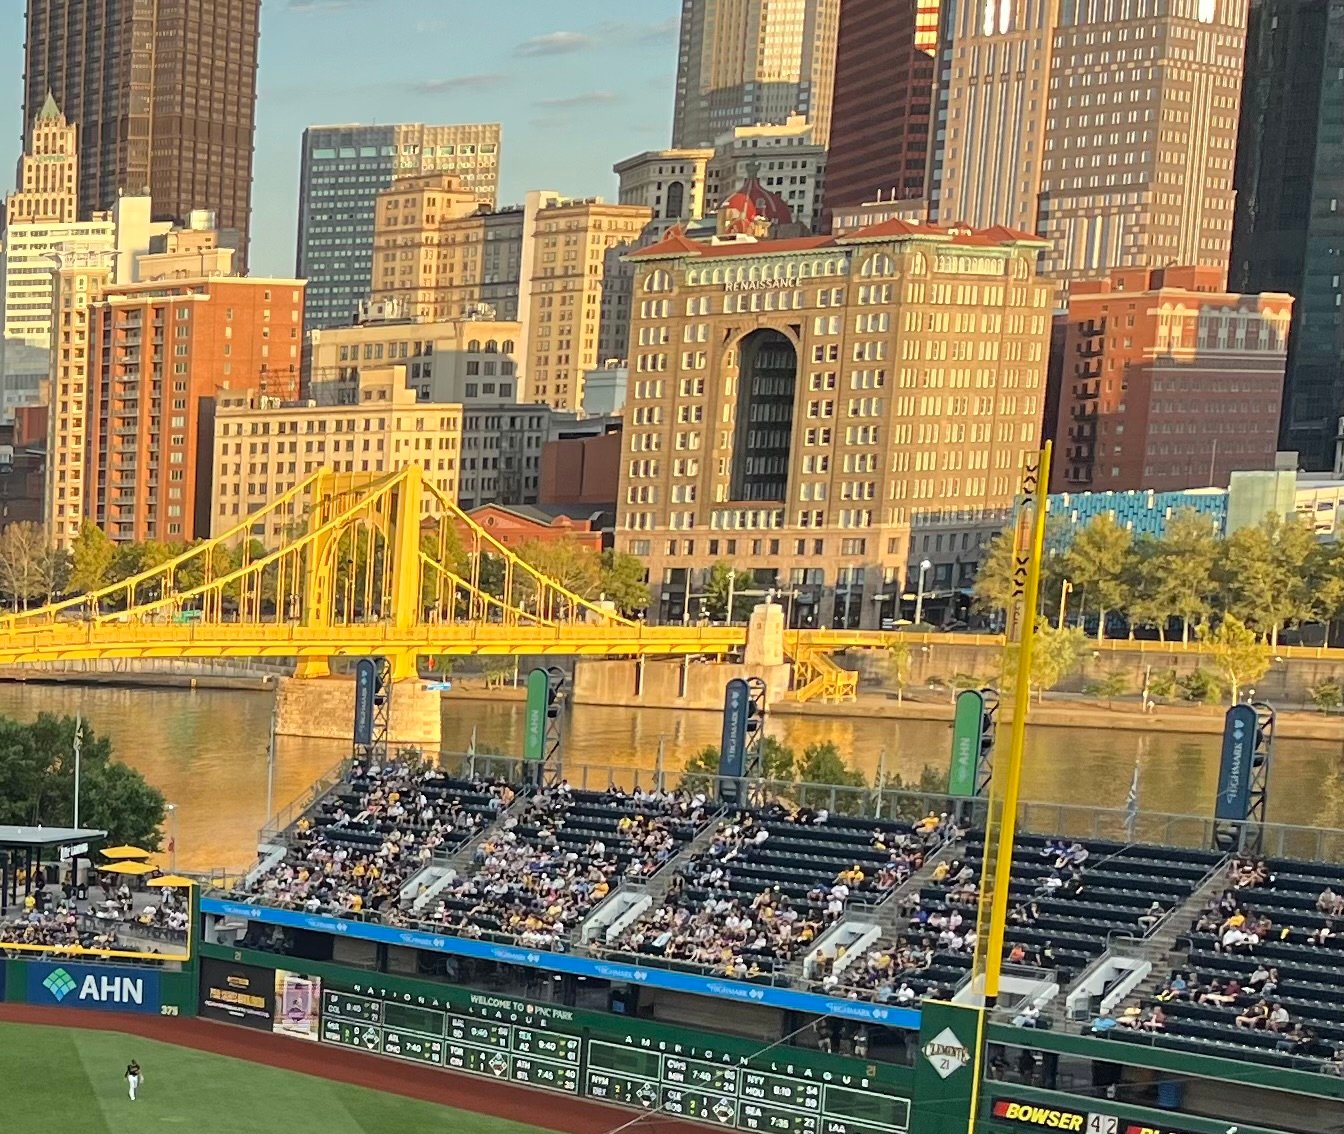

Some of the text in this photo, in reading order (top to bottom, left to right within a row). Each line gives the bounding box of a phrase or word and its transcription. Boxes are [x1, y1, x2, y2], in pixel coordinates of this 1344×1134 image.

[725, 278, 801, 292] RENAISSANCE
[1226, 742, 1243, 804] HIGHMARK
[79, 974, 143, 1004] AHN
[470, 994, 574, 1021] WELCOME TO PNC PARK
[940, 1058, 950, 1070] 21
[1005, 1103, 1084, 1132] BOWSER
